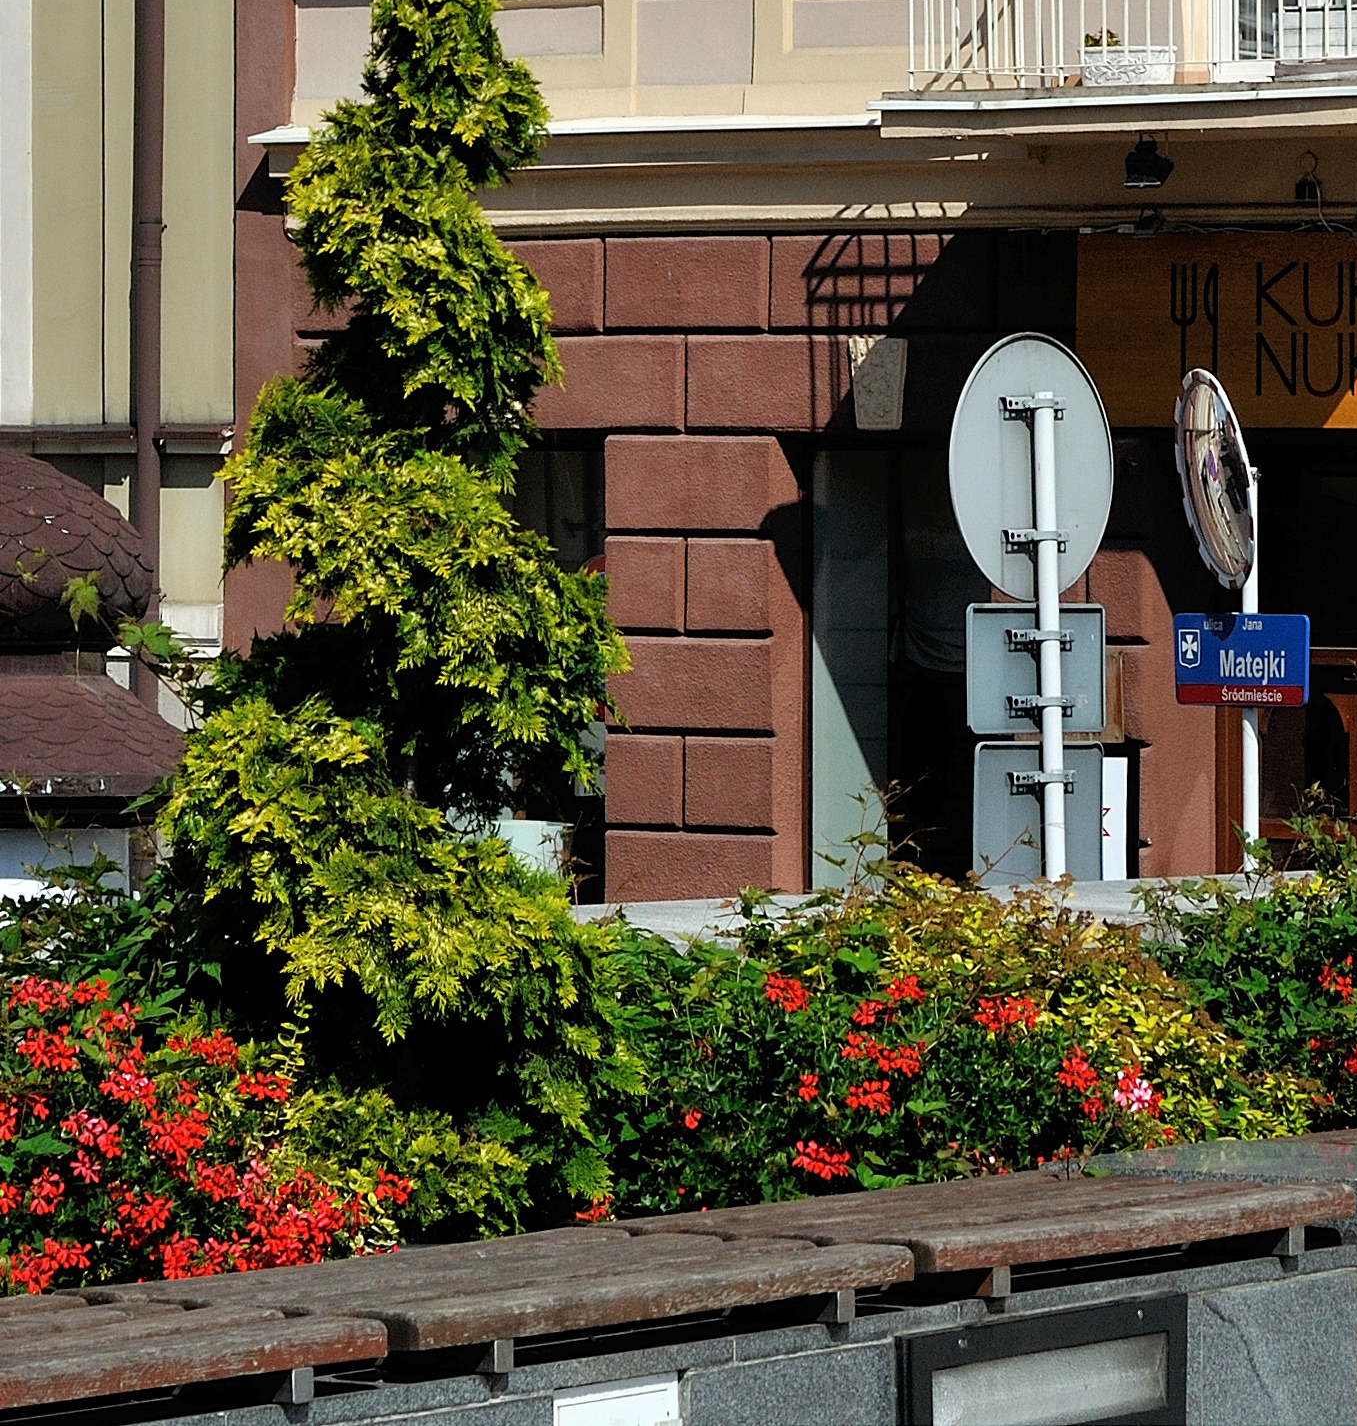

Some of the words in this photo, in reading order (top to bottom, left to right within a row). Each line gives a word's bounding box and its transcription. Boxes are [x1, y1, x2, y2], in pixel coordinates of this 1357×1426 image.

[1203, 618, 1223, 630] ulica
[1242, 618, 1262, 630] Jana
[1219, 649, 1285, 685] Matejki
[1221, 685, 1282, 702] Śródmieście
